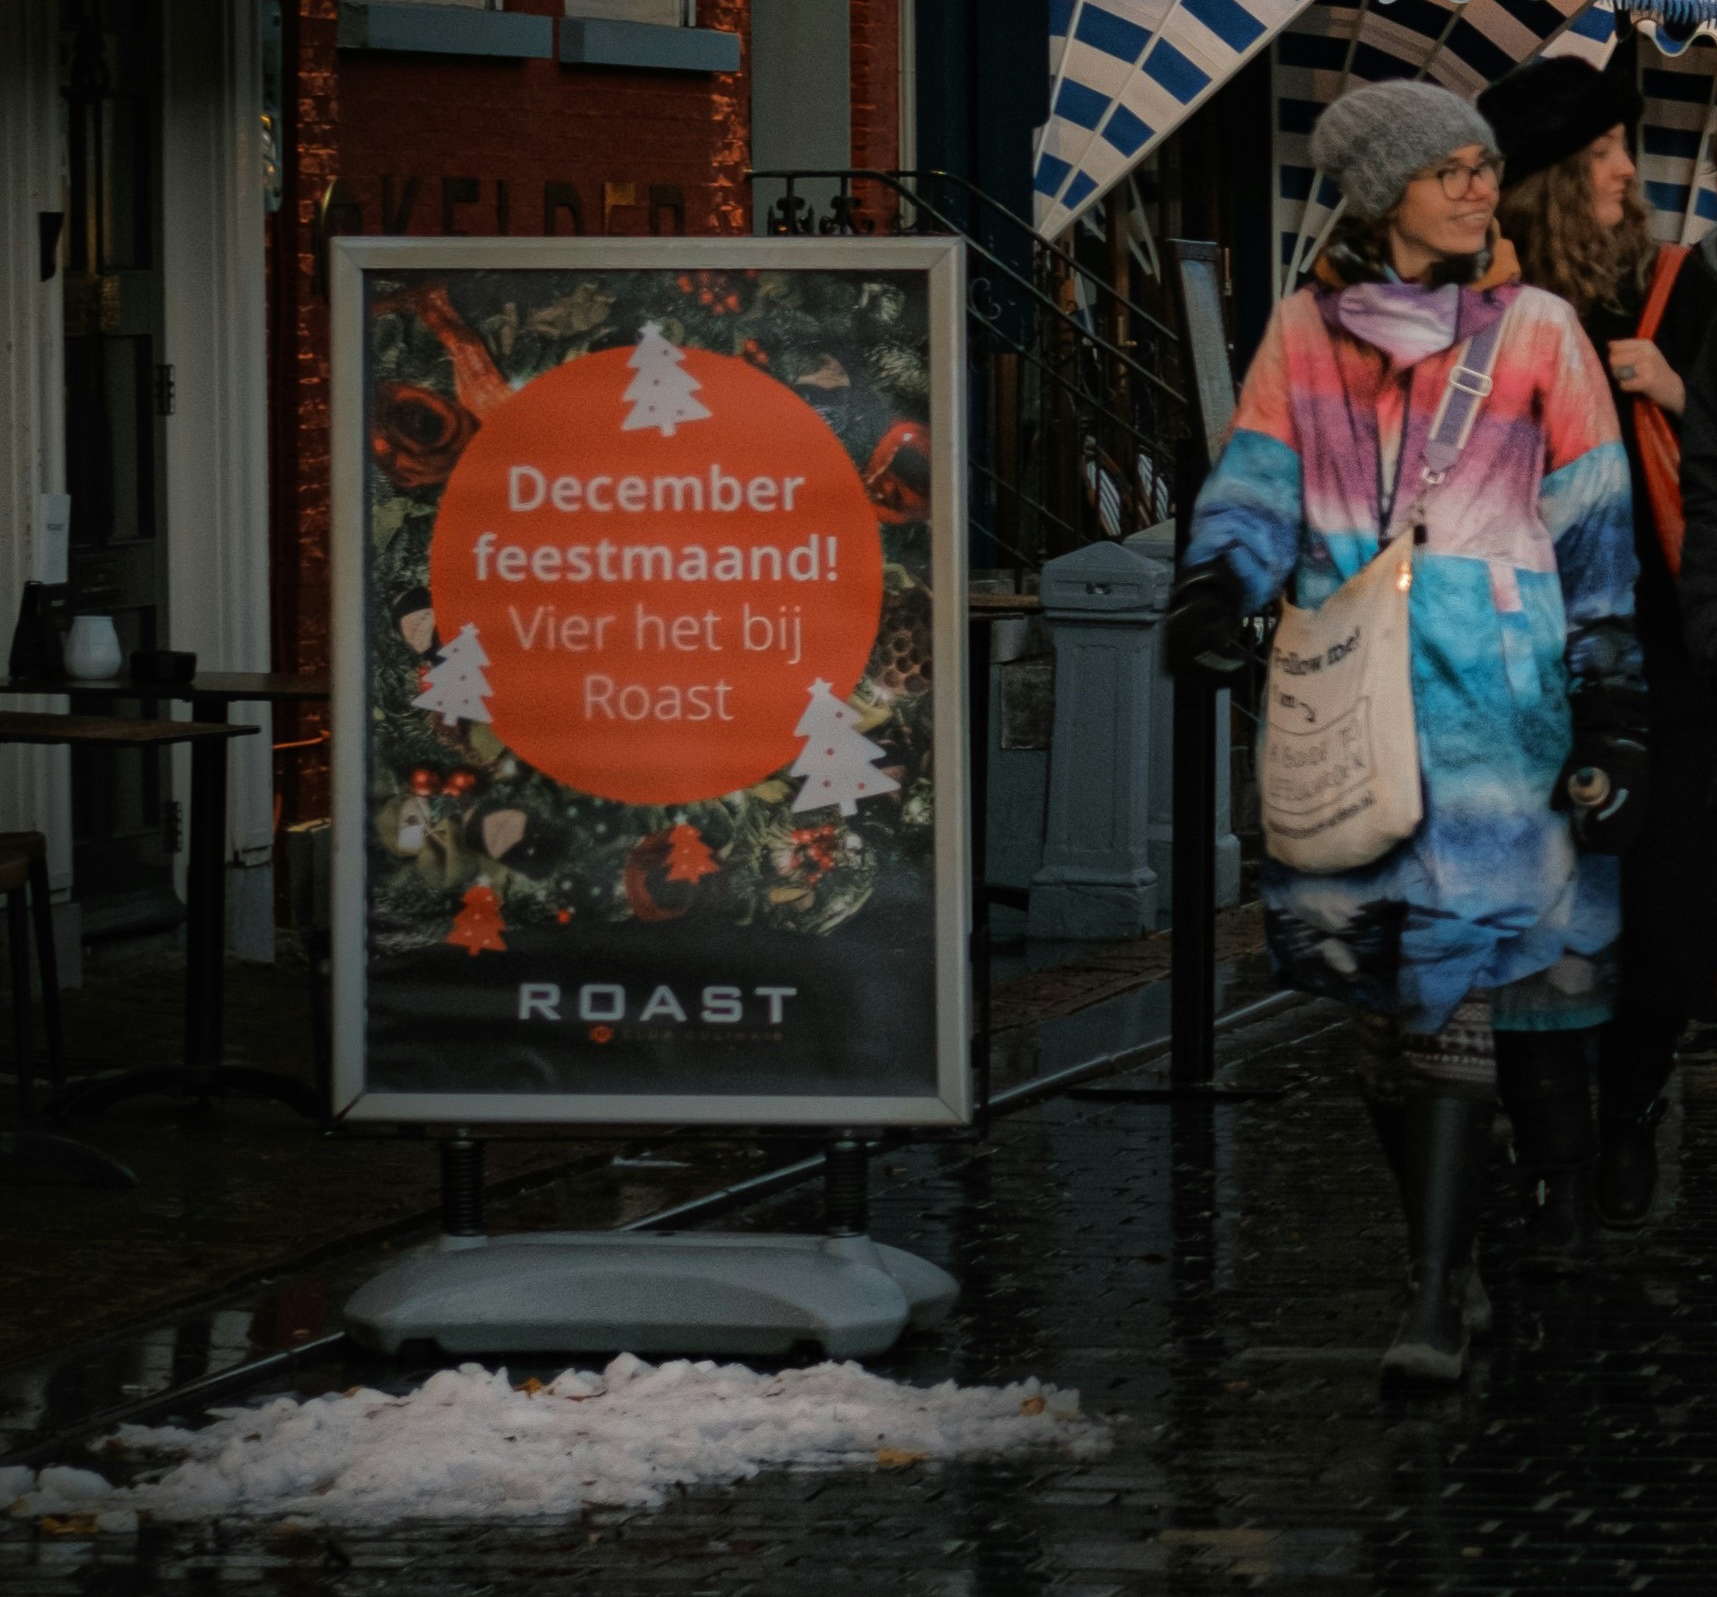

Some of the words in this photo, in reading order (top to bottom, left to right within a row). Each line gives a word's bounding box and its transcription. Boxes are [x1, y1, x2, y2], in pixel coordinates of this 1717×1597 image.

[506, 462, 806, 513] December
[471, 531, 840, 586] feestmaand!
[507, 604, 615, 651] Vier
[632, 602, 723, 652] het
[739, 602, 805, 667] bij
[581, 674, 735, 722] Roast
[516, 981, 798, 1024] ROAST
